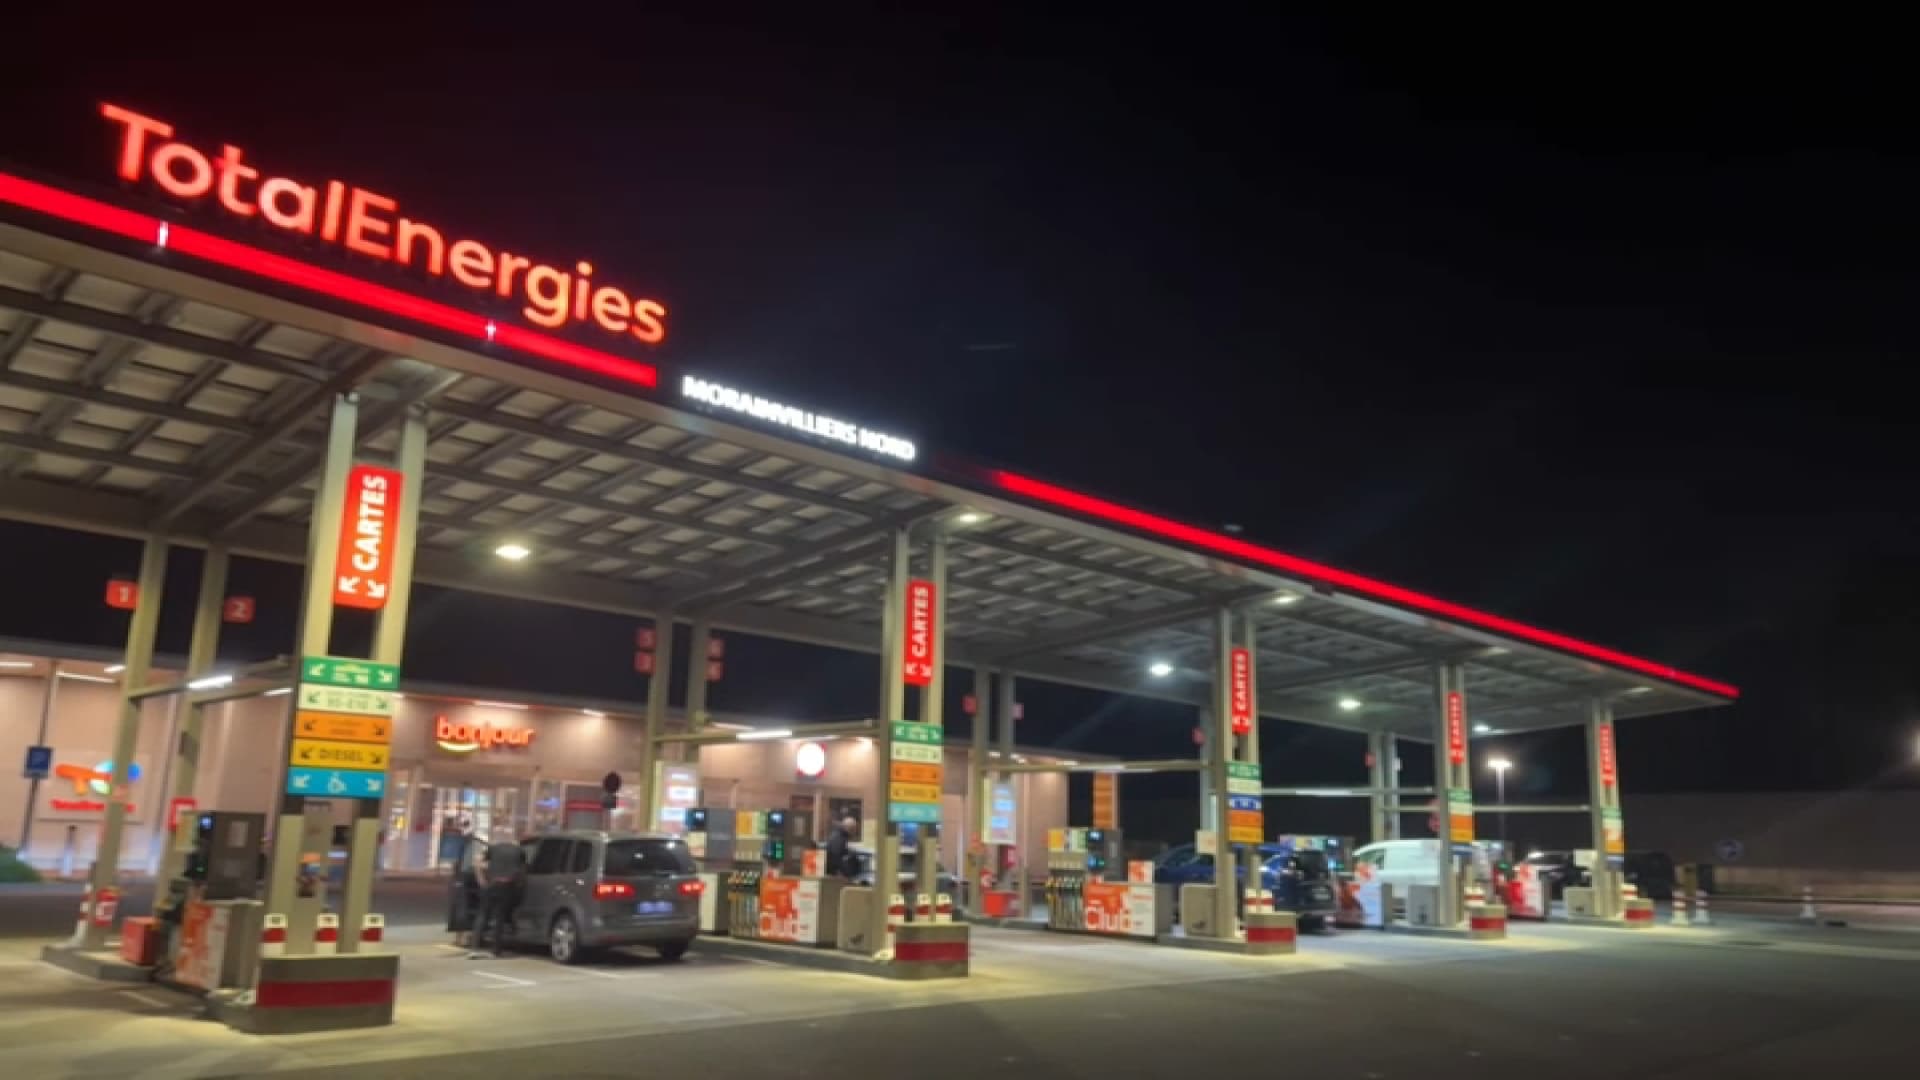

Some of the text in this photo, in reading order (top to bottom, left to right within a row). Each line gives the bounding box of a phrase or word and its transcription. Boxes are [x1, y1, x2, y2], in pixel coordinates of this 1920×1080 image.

[102, 103, 667, 344] TotalEnergies
[859, 428, 915, 461] NORD
[352, 474, 389, 572] CARTES
[911, 586, 929, 658] CARTES
[319, 748, 363, 762] DIESEL
[436, 714, 536, 749] bonjour
